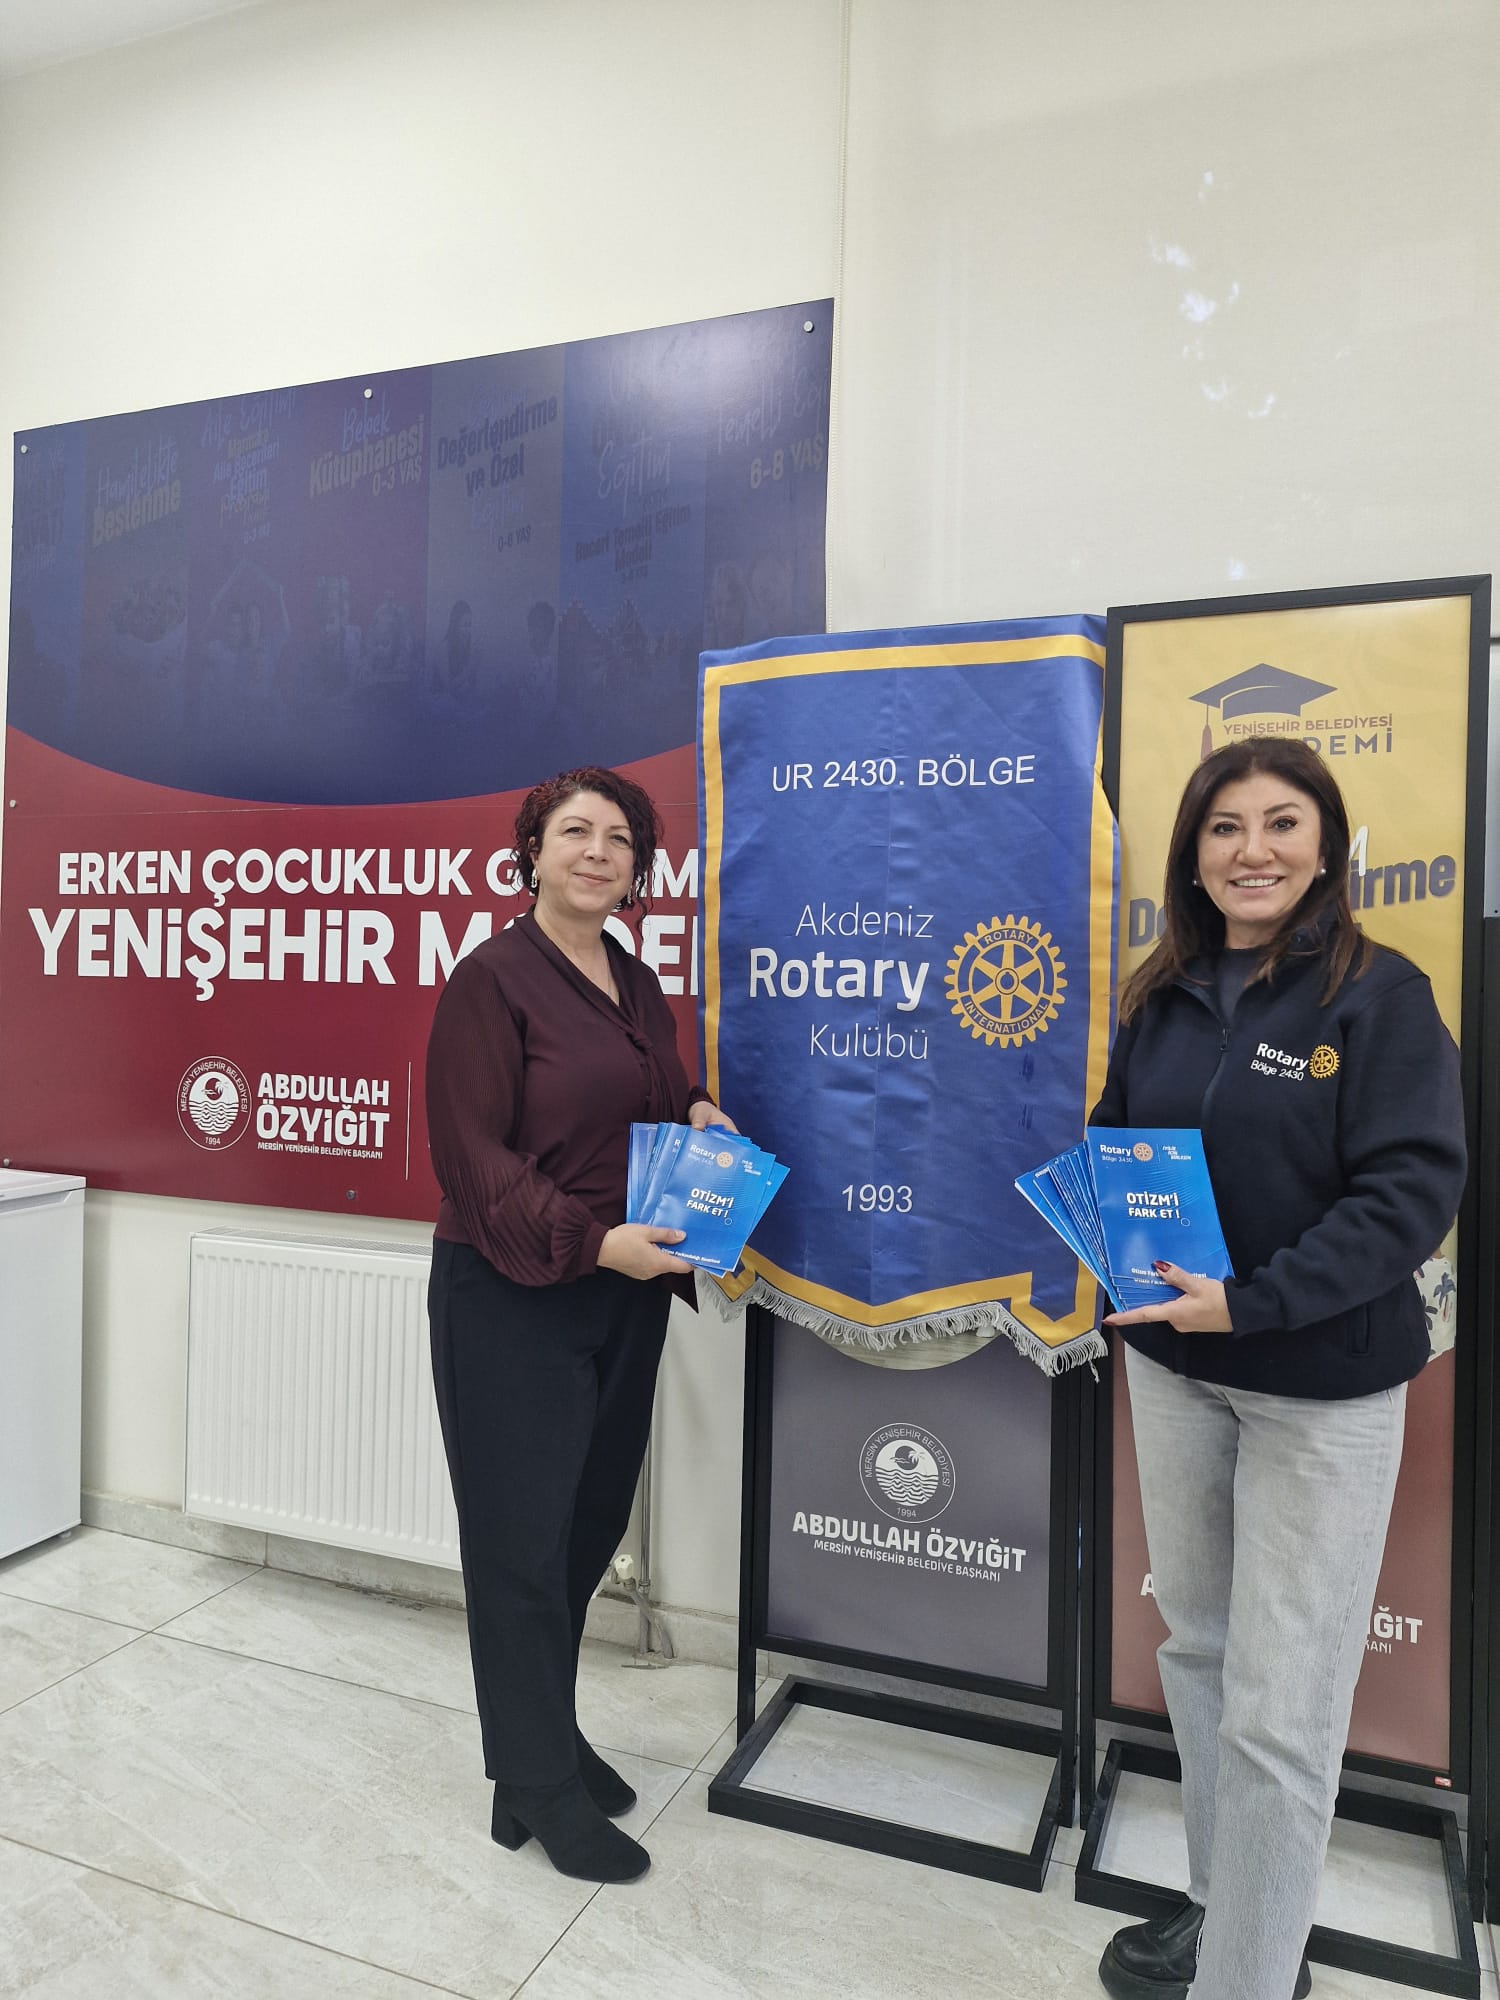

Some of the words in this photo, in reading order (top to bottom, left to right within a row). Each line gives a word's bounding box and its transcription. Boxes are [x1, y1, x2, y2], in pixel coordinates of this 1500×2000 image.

[437, 396, 558, 471] Değerlendirme
[751, 449, 784, 488] 6-8
[791, 433, 824, 473] YAŞ
[1223, 719, 1300, 736] YENİŞEHİR
[1305, 713, 1393, 731] BELEDİYESİ
[772, 763, 814, 792] UR
[823, 759, 905, 789] 2430.
[918, 754, 1036, 786] BÖLGE
[59, 849, 192, 896] ERKEN
[202, 848, 472, 907] ÇOCUKLUK
[795, 901, 934, 939] Akdeniz
[984, 929, 1034, 945] ROTARY
[28, 907, 396, 1001] YENİŞEHİR
[749, 947, 930, 1012] Rotary
[965, 1001, 1048, 1034] INTERNATIONAL
[810, 1024, 928, 1060] Kulübü
[1256, 1042, 1309, 1071] Rotary
[180, 1077, 193, 1112] MERSİN
[190, 1061, 226, 1082] YENİŞEHİR
[225, 1066, 248, 1113] BELEDİYESİ
[1250, 1059, 1277, 1075] Bölge
[1279, 1068, 1304, 1081] 2430
[257, 1072, 390, 1106] ABDULLAH
[256, 1097, 390, 1148] ÖZYİĞİT
[205, 1136, 221, 1145] 1994
[257, 1141, 284, 1151] MERSİN
[284, 1143, 319, 1154] YENİŞEHİR
[320, 1146, 351, 1157] BELEDİYE
[352, 1149, 383, 1160] BAŞKANI
[690, 1144, 717, 1160] Rotary
[1100, 1144, 1131, 1156] Rotary
[686, 1199, 709, 1214] FARK
[711, 1207, 723, 1217] ET
[841, 1184, 913, 1213] 1993
[1128, 1207, 1157, 1219] FARK
[1160, 1208, 1174, 1219] ET
[865, 1443, 878, 1478] MERSİN
[875, 1428, 922, 1447] YENİŞEHİR
[921, 1436, 951, 1487] BELEDİYESİ
[896, 1506, 917, 1518] 1994
[792, 1511, 921, 1553] ABDULLAH
[926, 1528, 1027, 1572] ÖZYİĞİT
[813, 1539, 852, 1555] MERSİN
[853, 1546, 905, 1565] YENİŞEHİR
[907, 1557, 954, 1574] BELEDİYE
[955, 1565, 1001, 1583] BAŞKANI
